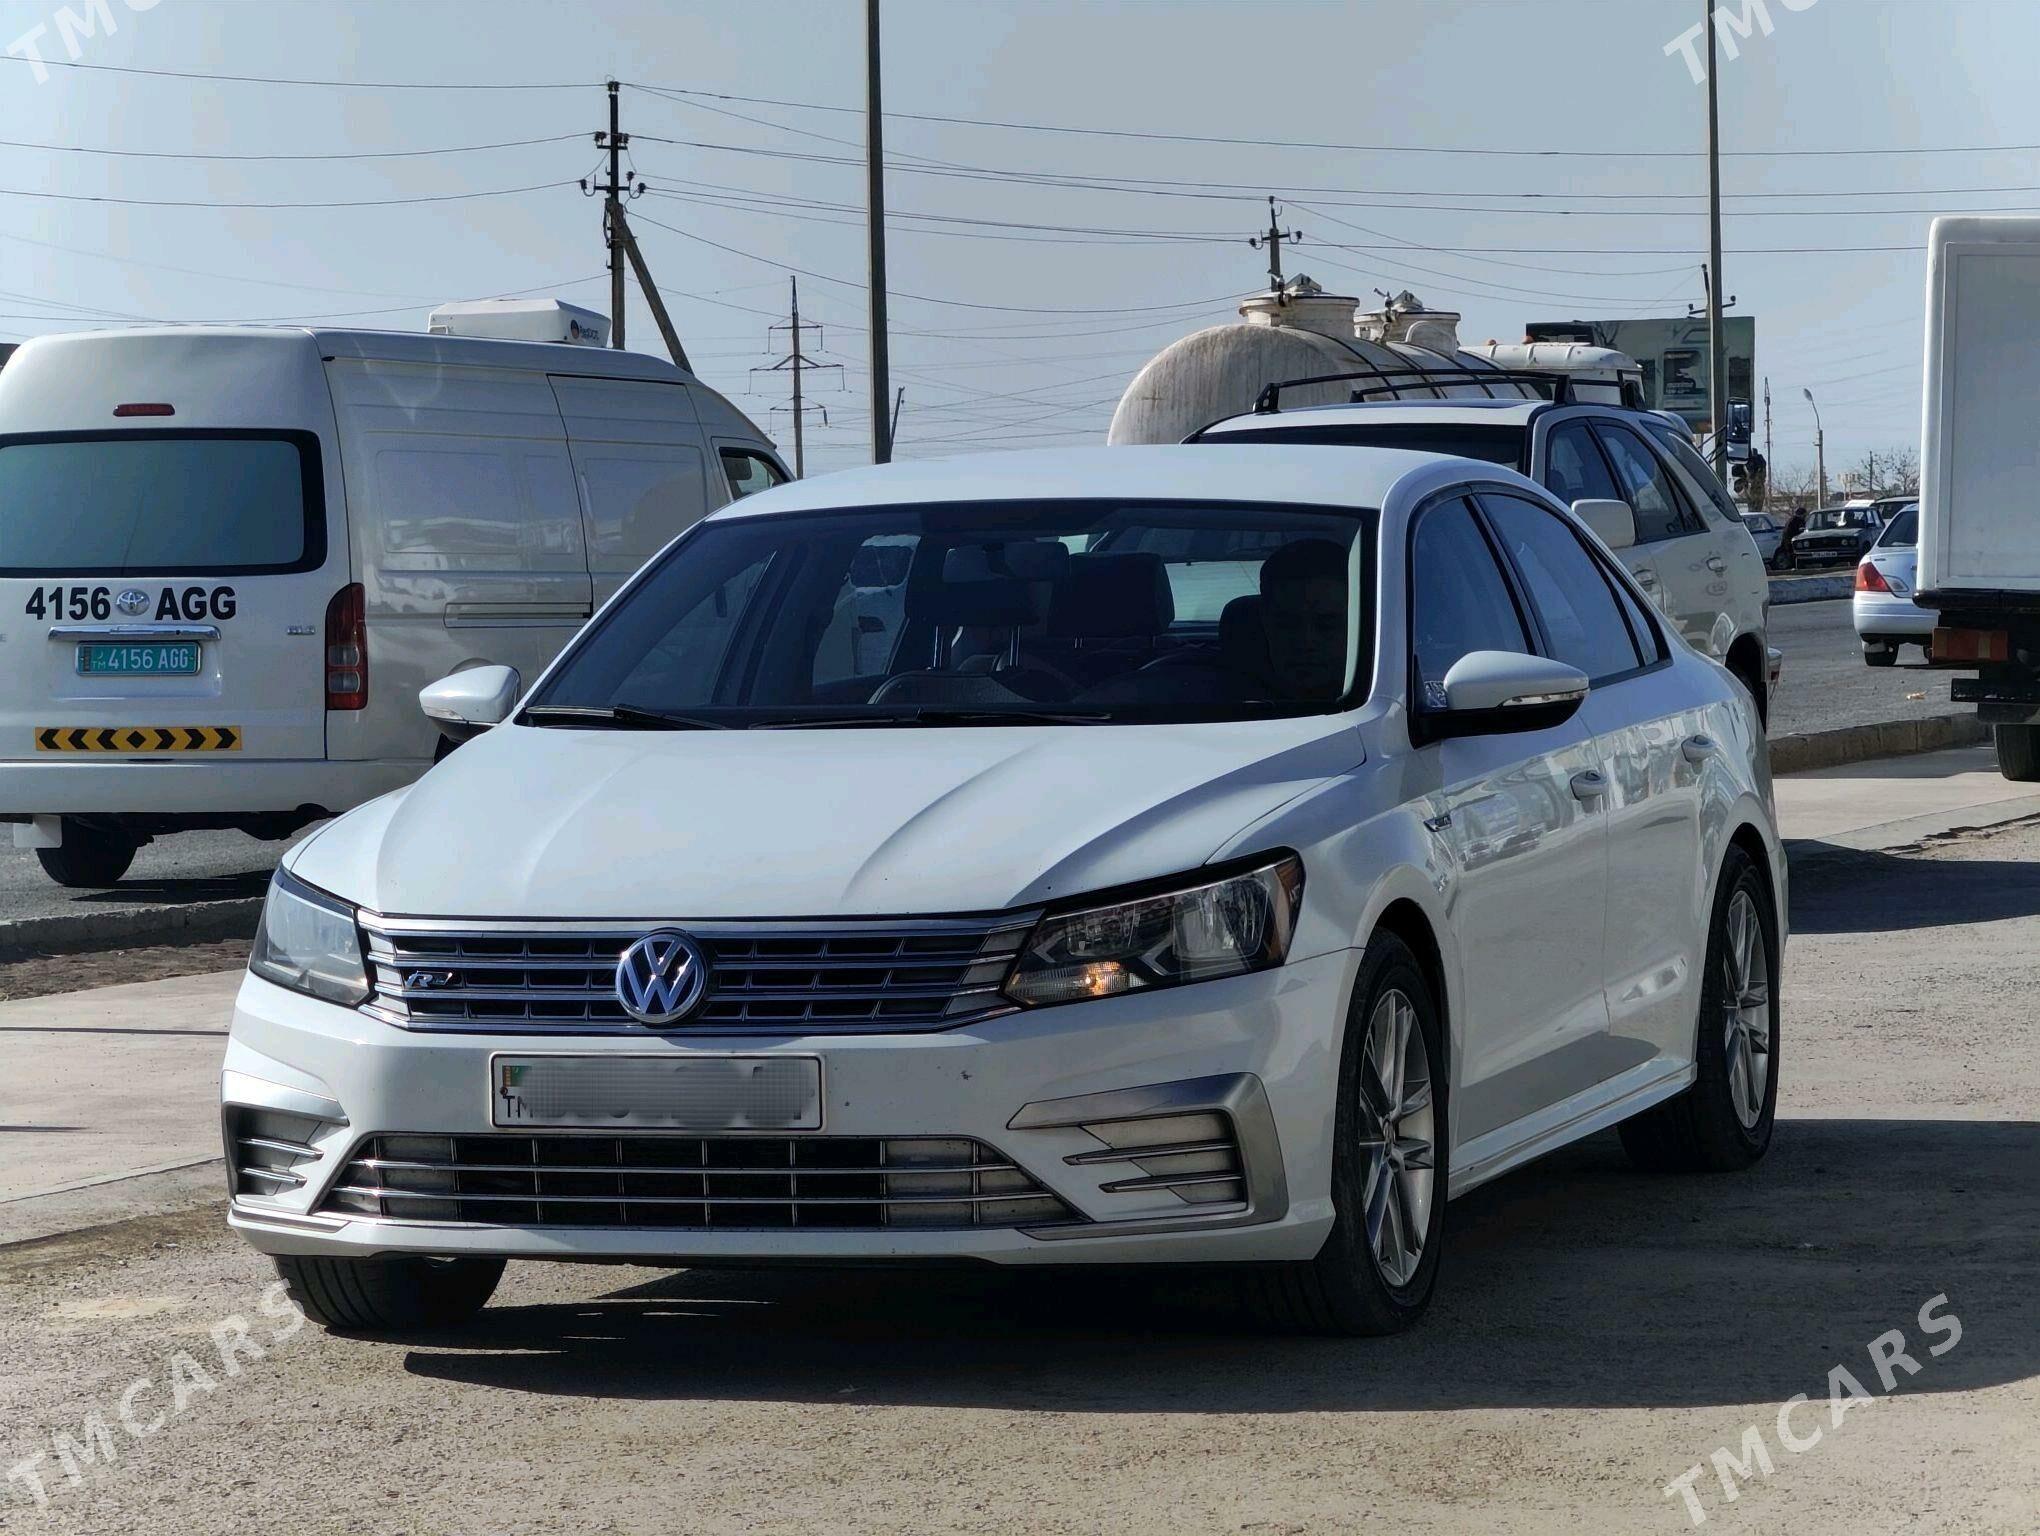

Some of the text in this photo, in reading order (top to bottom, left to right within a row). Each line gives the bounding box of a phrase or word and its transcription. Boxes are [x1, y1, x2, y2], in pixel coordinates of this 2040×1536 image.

[25, 586, 236, 620] 4156 AGG
[108, 648, 153, 669] 4156
[158, 648, 189, 669] AGG
